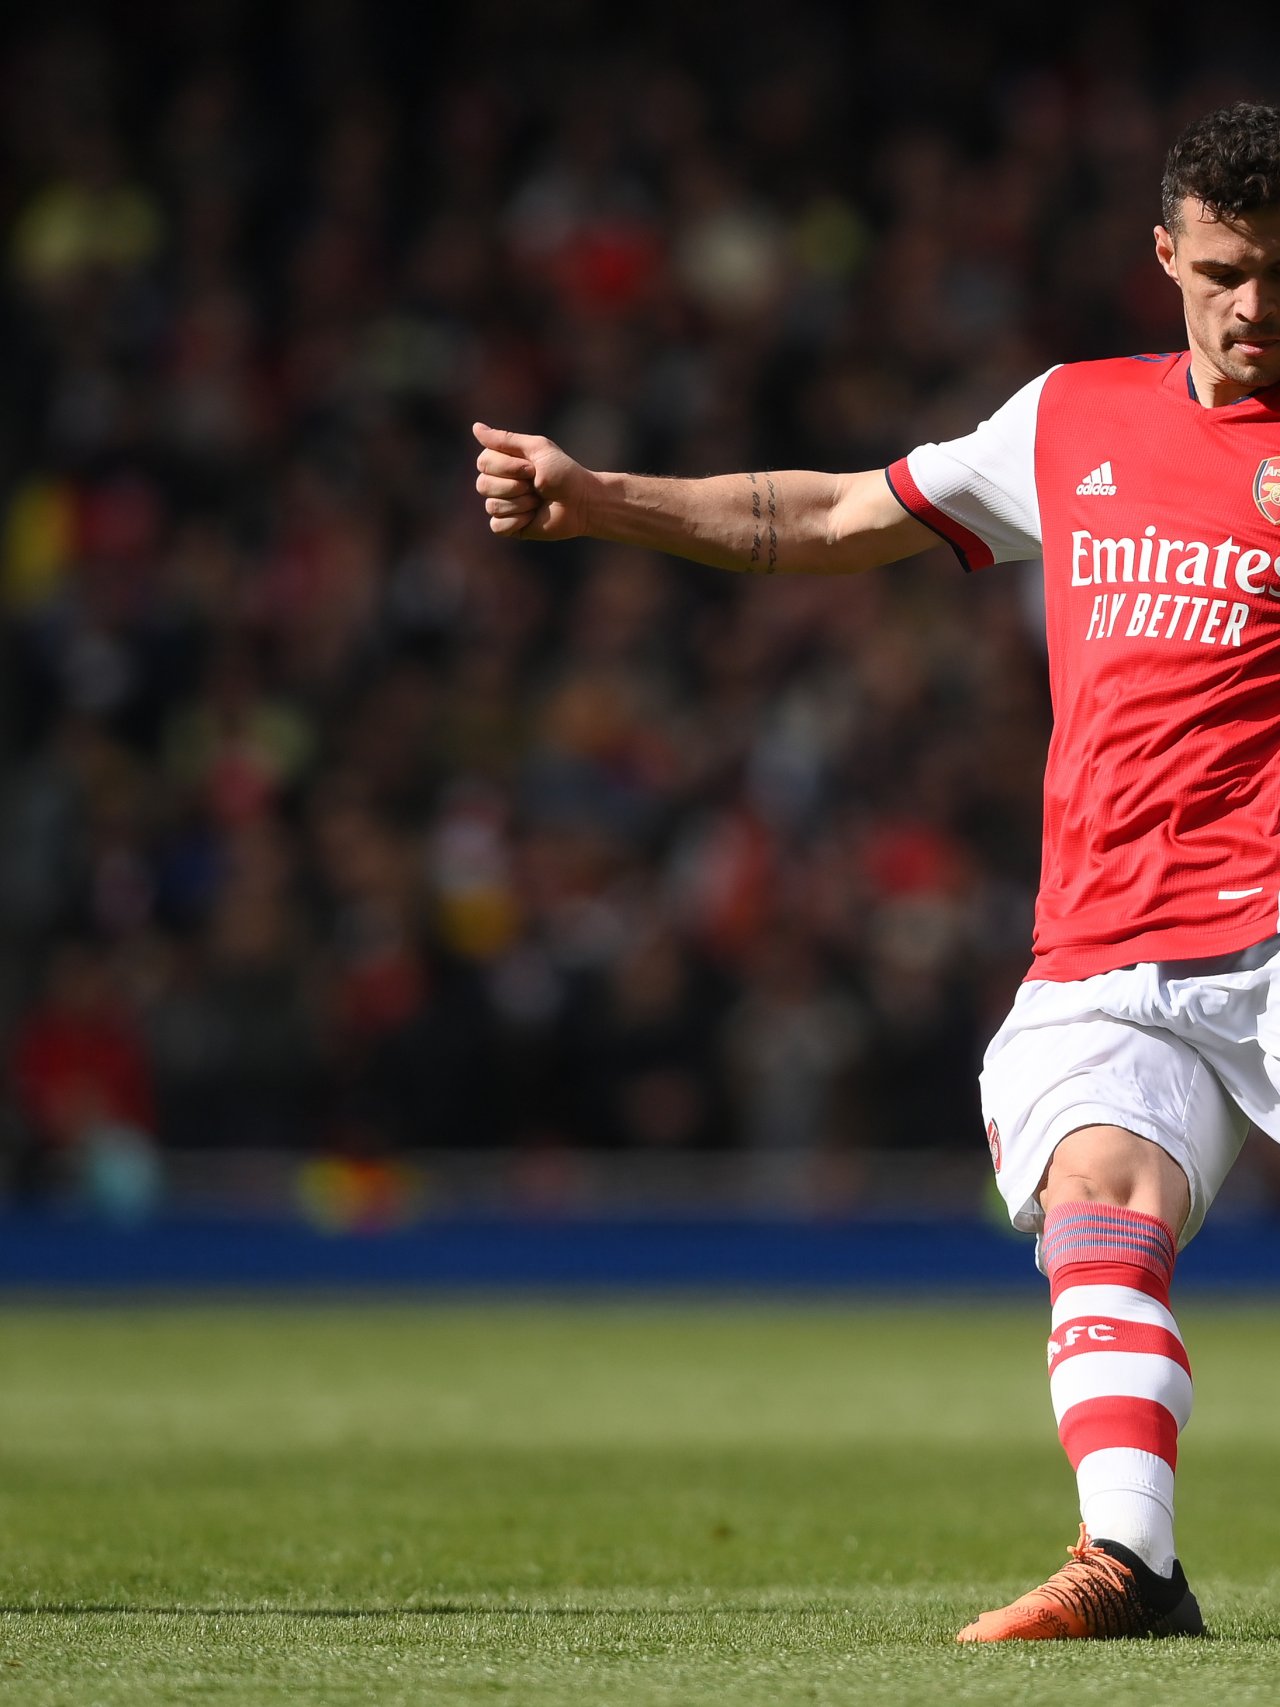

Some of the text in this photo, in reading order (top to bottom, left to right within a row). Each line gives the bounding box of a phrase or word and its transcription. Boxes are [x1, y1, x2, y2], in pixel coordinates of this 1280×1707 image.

[1076, 483, 1117, 496] adidas
[1085, 592, 1250, 647] FLY BETTER
